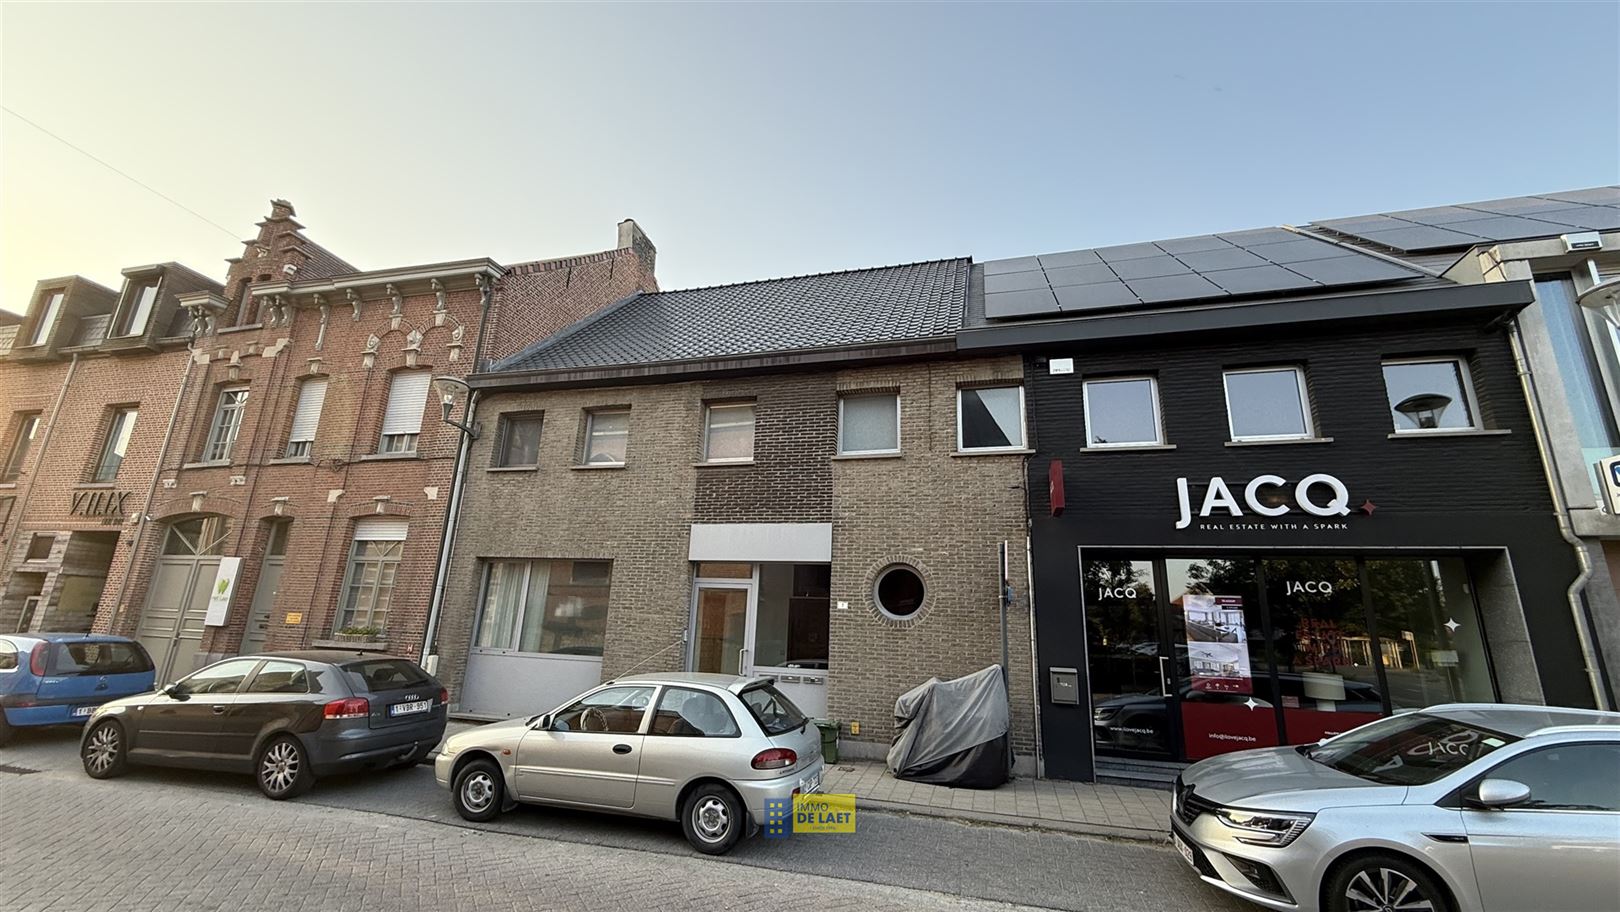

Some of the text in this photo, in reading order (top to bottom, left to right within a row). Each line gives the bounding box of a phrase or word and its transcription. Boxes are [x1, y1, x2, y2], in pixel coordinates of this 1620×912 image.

[1175, 473, 1351, 530] JACQ
[1097, 586, 1138, 601] JACQ
[1286, 581, 1333, 595] JACQ
[1208, 733, 1257, 742] info@ilovejacq.be
